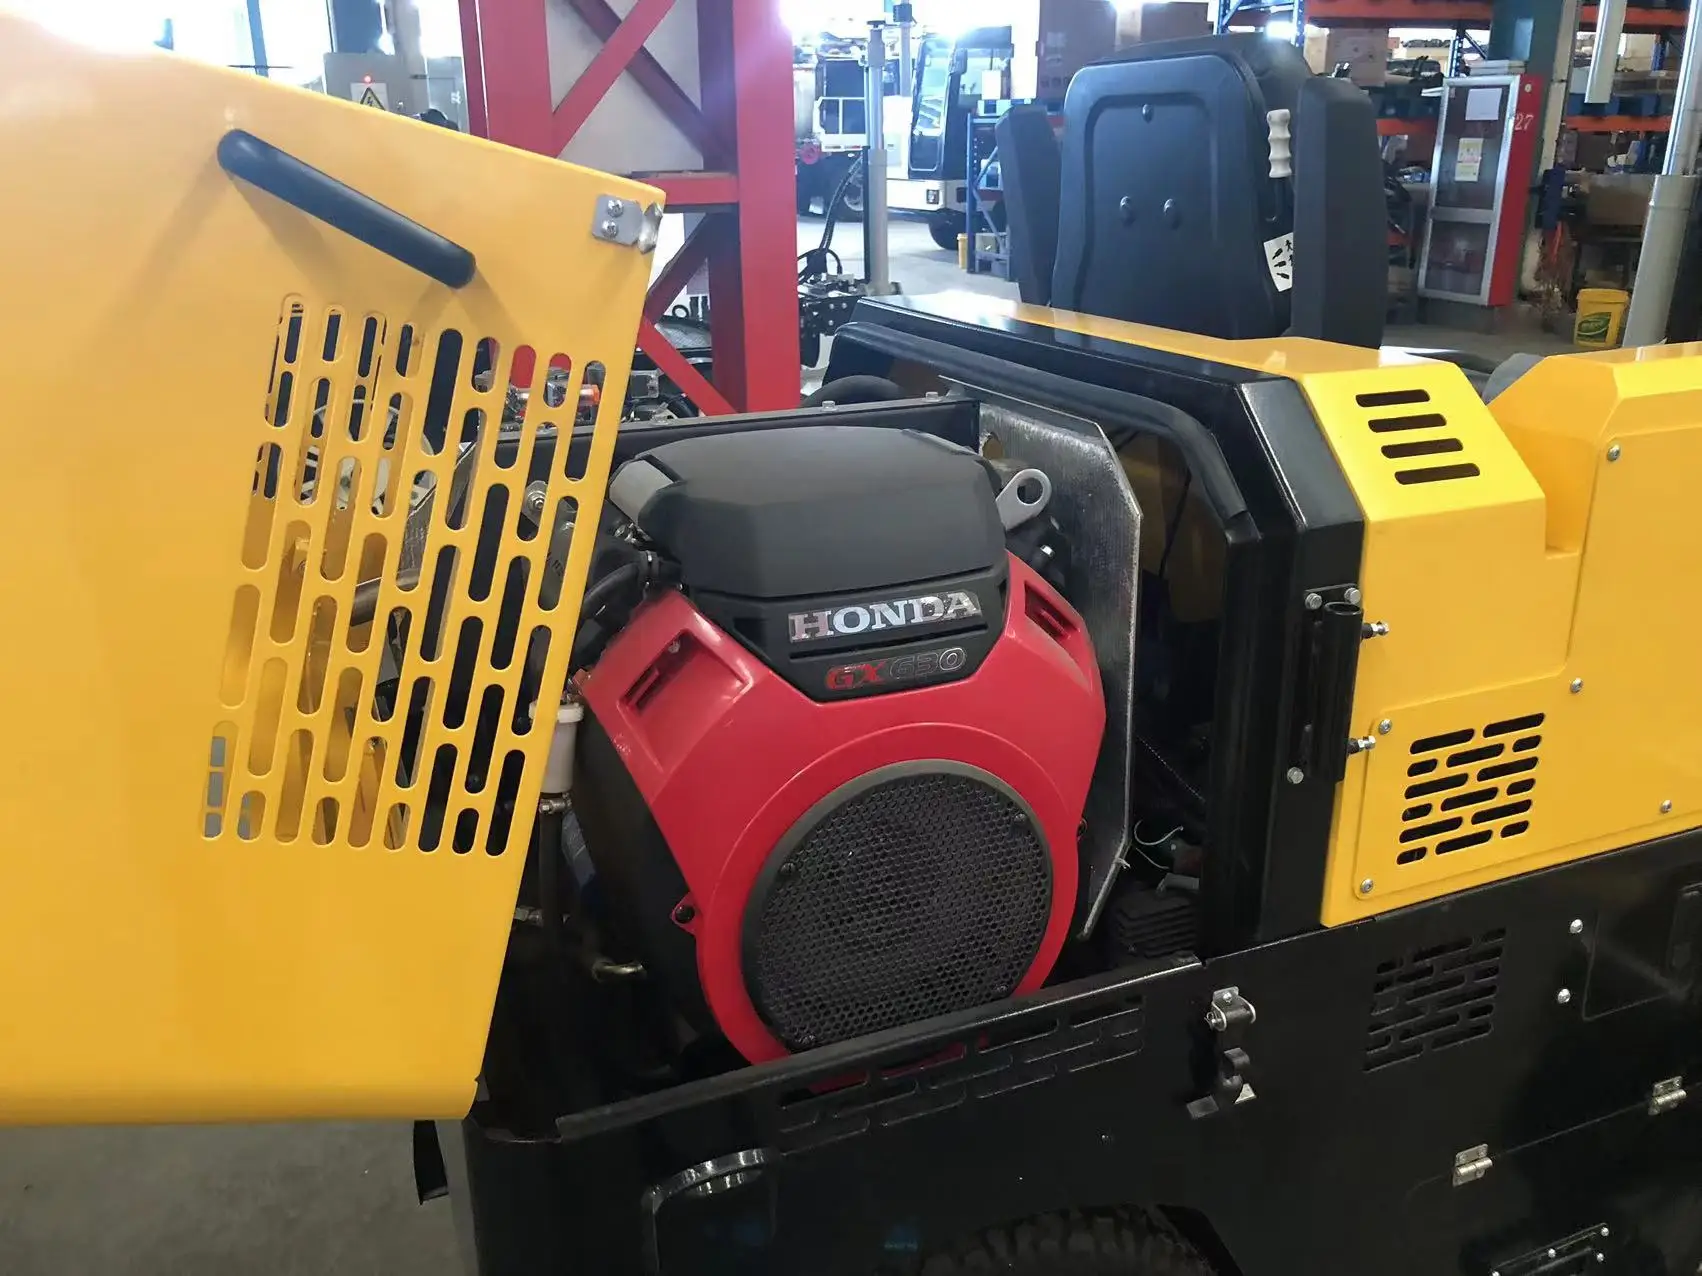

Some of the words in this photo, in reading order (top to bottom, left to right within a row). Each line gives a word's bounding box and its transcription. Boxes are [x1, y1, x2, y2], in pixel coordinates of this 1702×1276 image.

[1514, 112, 1534, 131] 27
[789, 591, 982, 642] HONDA
[826, 647, 966, 690] GX630
